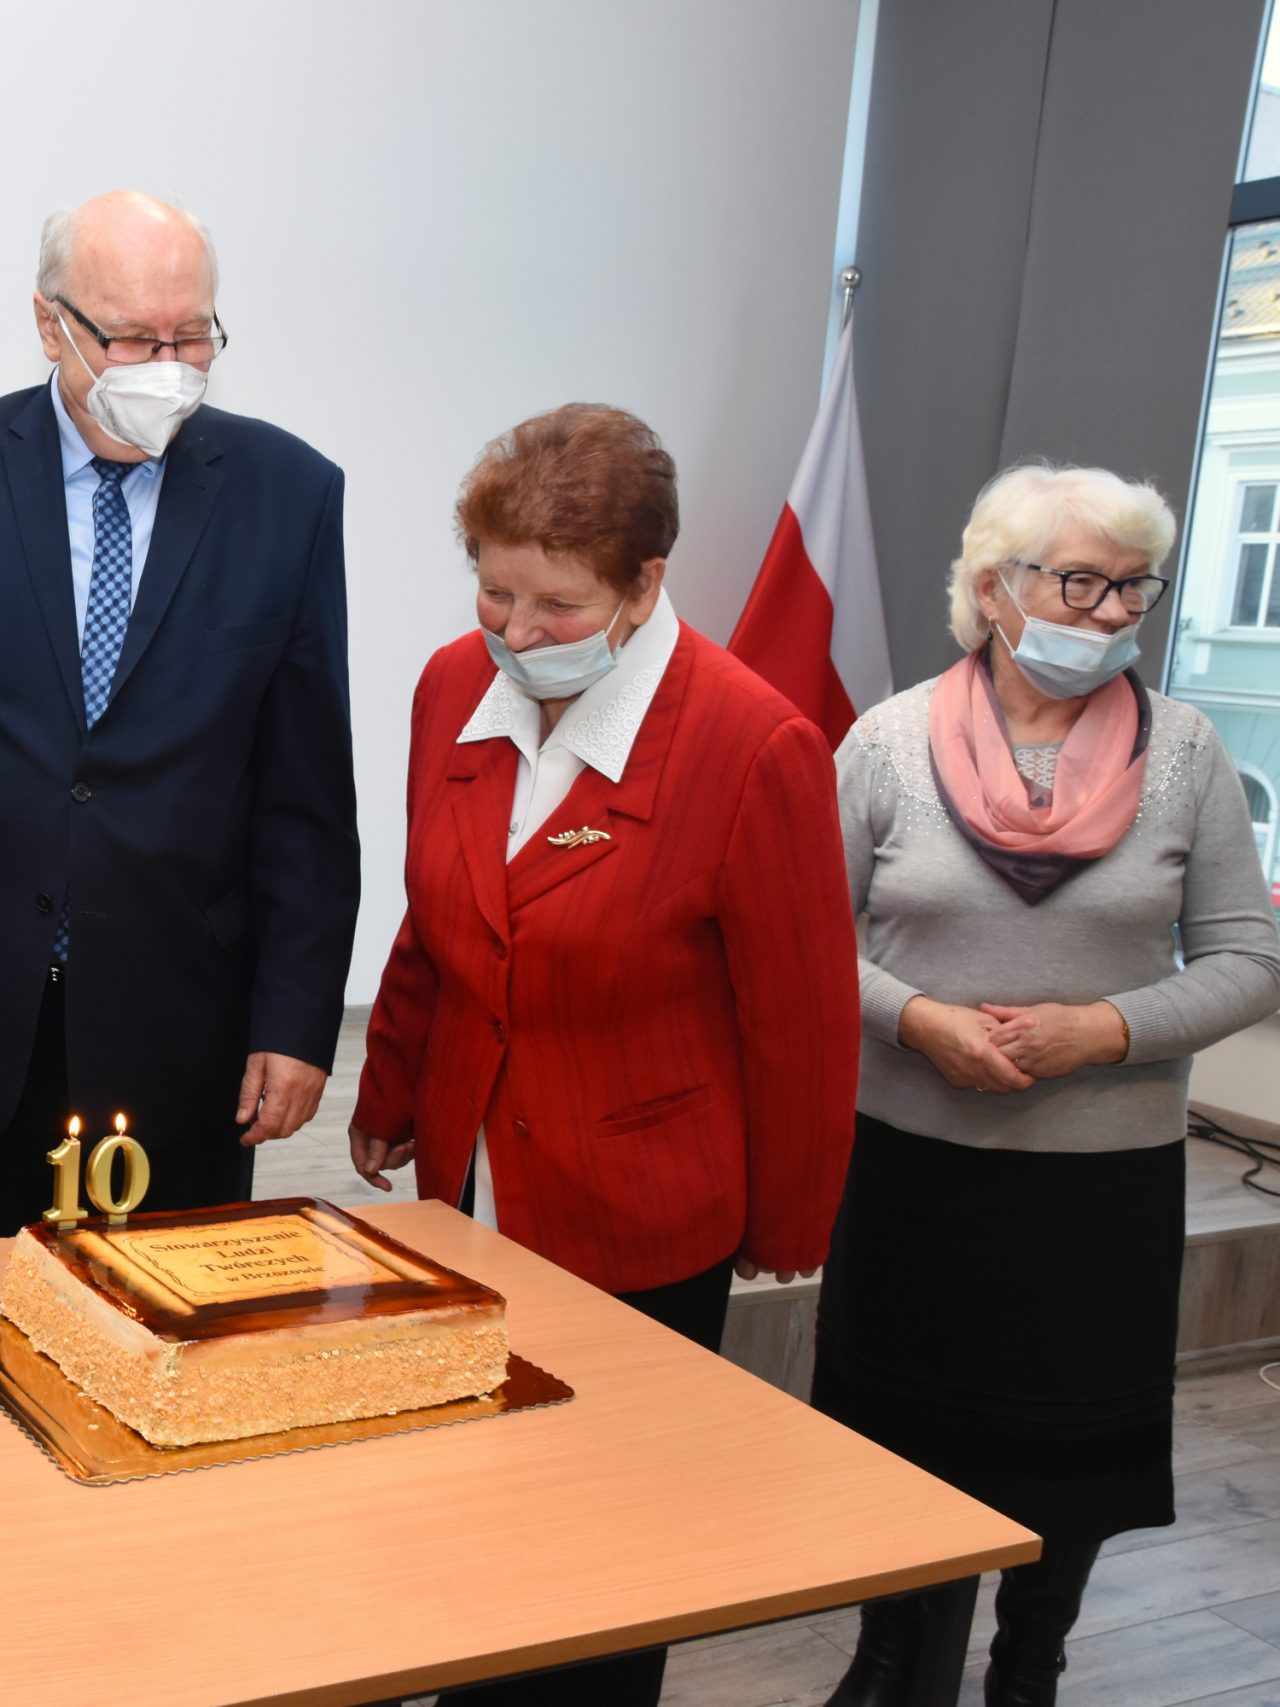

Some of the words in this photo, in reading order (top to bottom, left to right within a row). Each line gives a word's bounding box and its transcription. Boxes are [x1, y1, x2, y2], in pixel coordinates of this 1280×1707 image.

[42, 1135, 150, 1223] 10
[149, 1230, 302, 1252] Stowarzyszenie
[216, 1246, 275, 1259] Ludzi
[200, 1254, 310, 1273] Twórczych
[226, 1275, 240, 1283] w
[240, 1265, 326, 1281] Brzozowie
